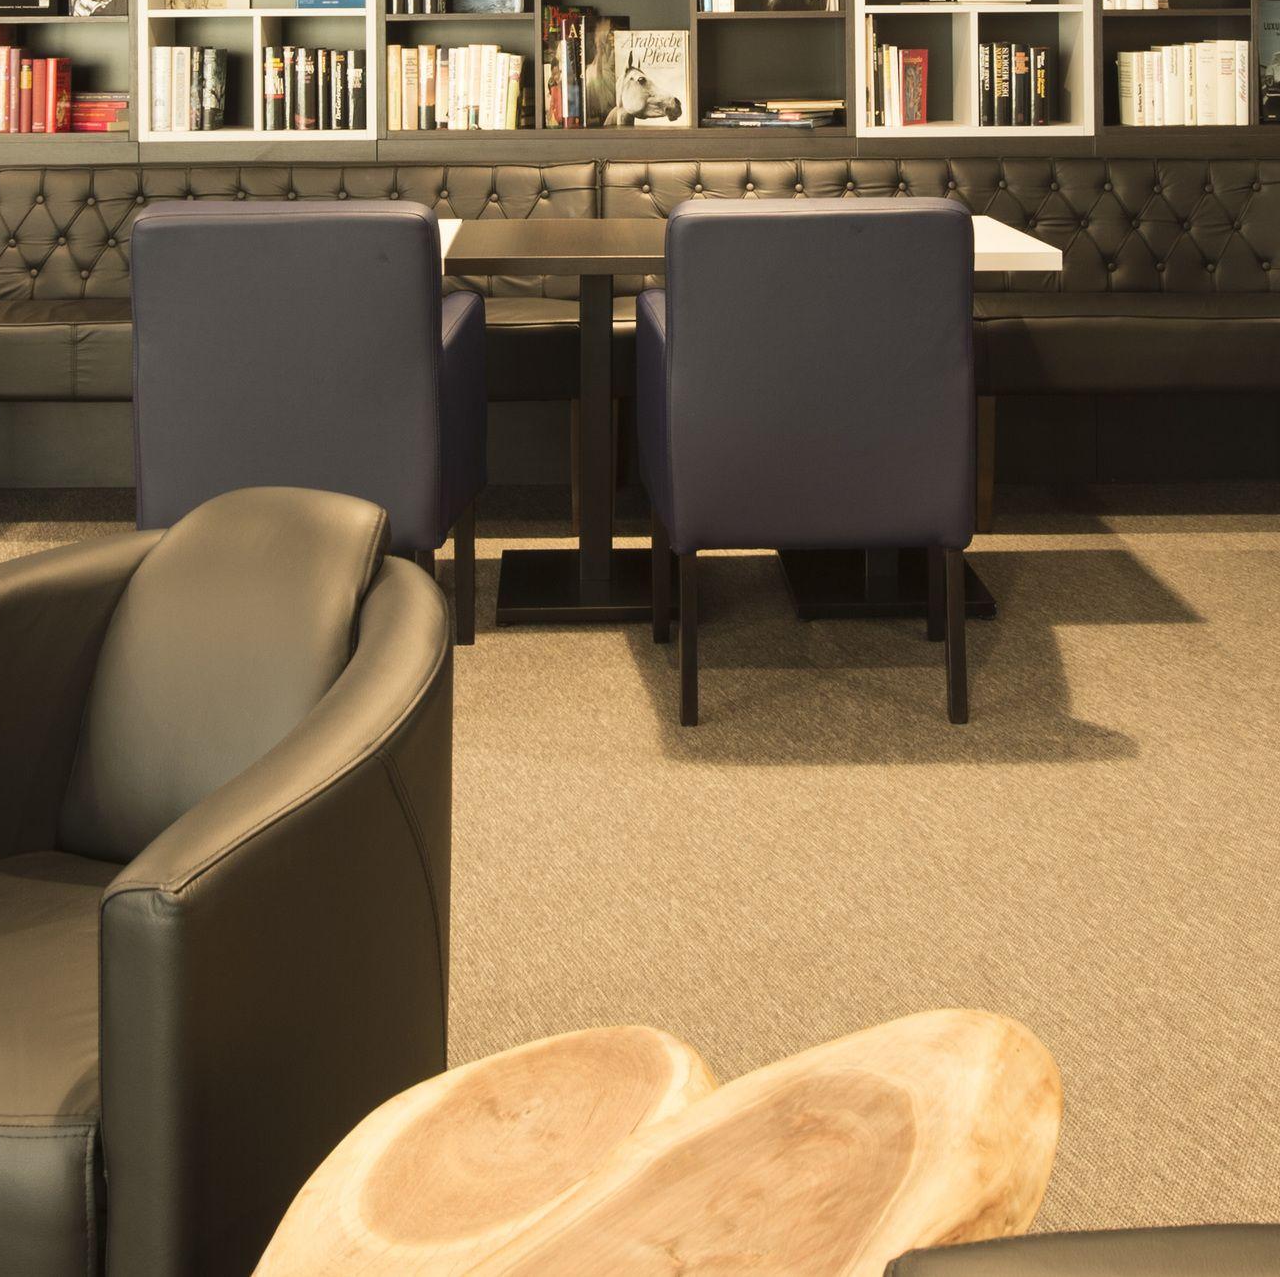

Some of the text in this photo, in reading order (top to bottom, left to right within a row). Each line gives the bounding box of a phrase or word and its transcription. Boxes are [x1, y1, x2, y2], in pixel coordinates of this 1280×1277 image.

[621, 33, 683, 48] Arabische
[642, 48, 682, 64] Pferde
[1001, 47, 1009, 97] DER MEDICUS
